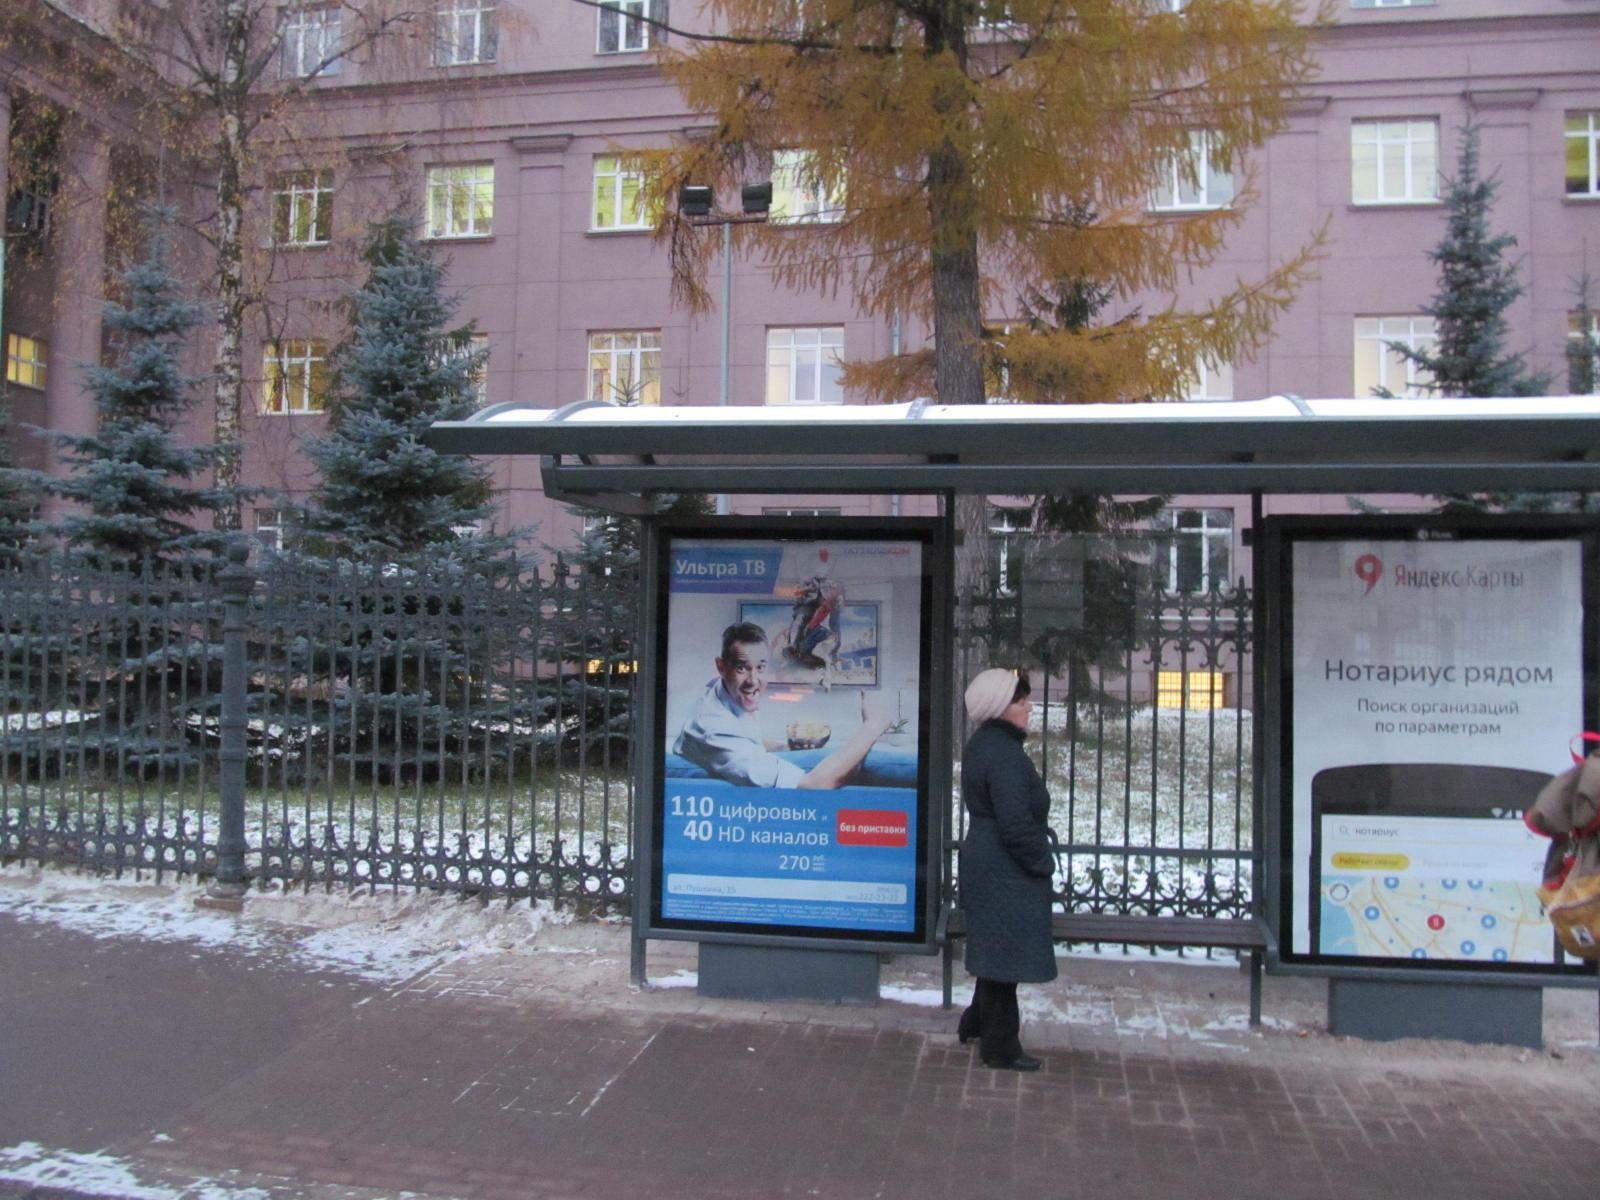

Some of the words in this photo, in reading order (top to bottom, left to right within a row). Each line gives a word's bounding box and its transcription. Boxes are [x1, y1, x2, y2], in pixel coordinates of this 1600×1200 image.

[676, 560, 738, 578] Ультра
[743, 560, 766, 574] ТВ
[1394, 565, 1461, 588] Яндекс
[1466, 565, 1524, 590] Карты
[1325, 659, 1456, 688] Нотариус
[1464, 663, 1553, 687] рядом
[1357, 699, 1407, 713] Поиск
[1411, 699, 1519, 716] организаций
[1375, 722, 1394, 733] по
[1398, 722, 1501, 736] параметрам
[671, 795, 714, 817] 110
[719, 802, 817, 823] цифровых
[683, 820, 713, 841] 40
[719, 826, 745, 842] HD
[751, 828, 829, 846] каналов
[839, 822, 856, 833] без
[857, 823, 906, 835] приставки
[1355, 826, 1399, 838] нотариус
[778, 855, 810, 871] 270
